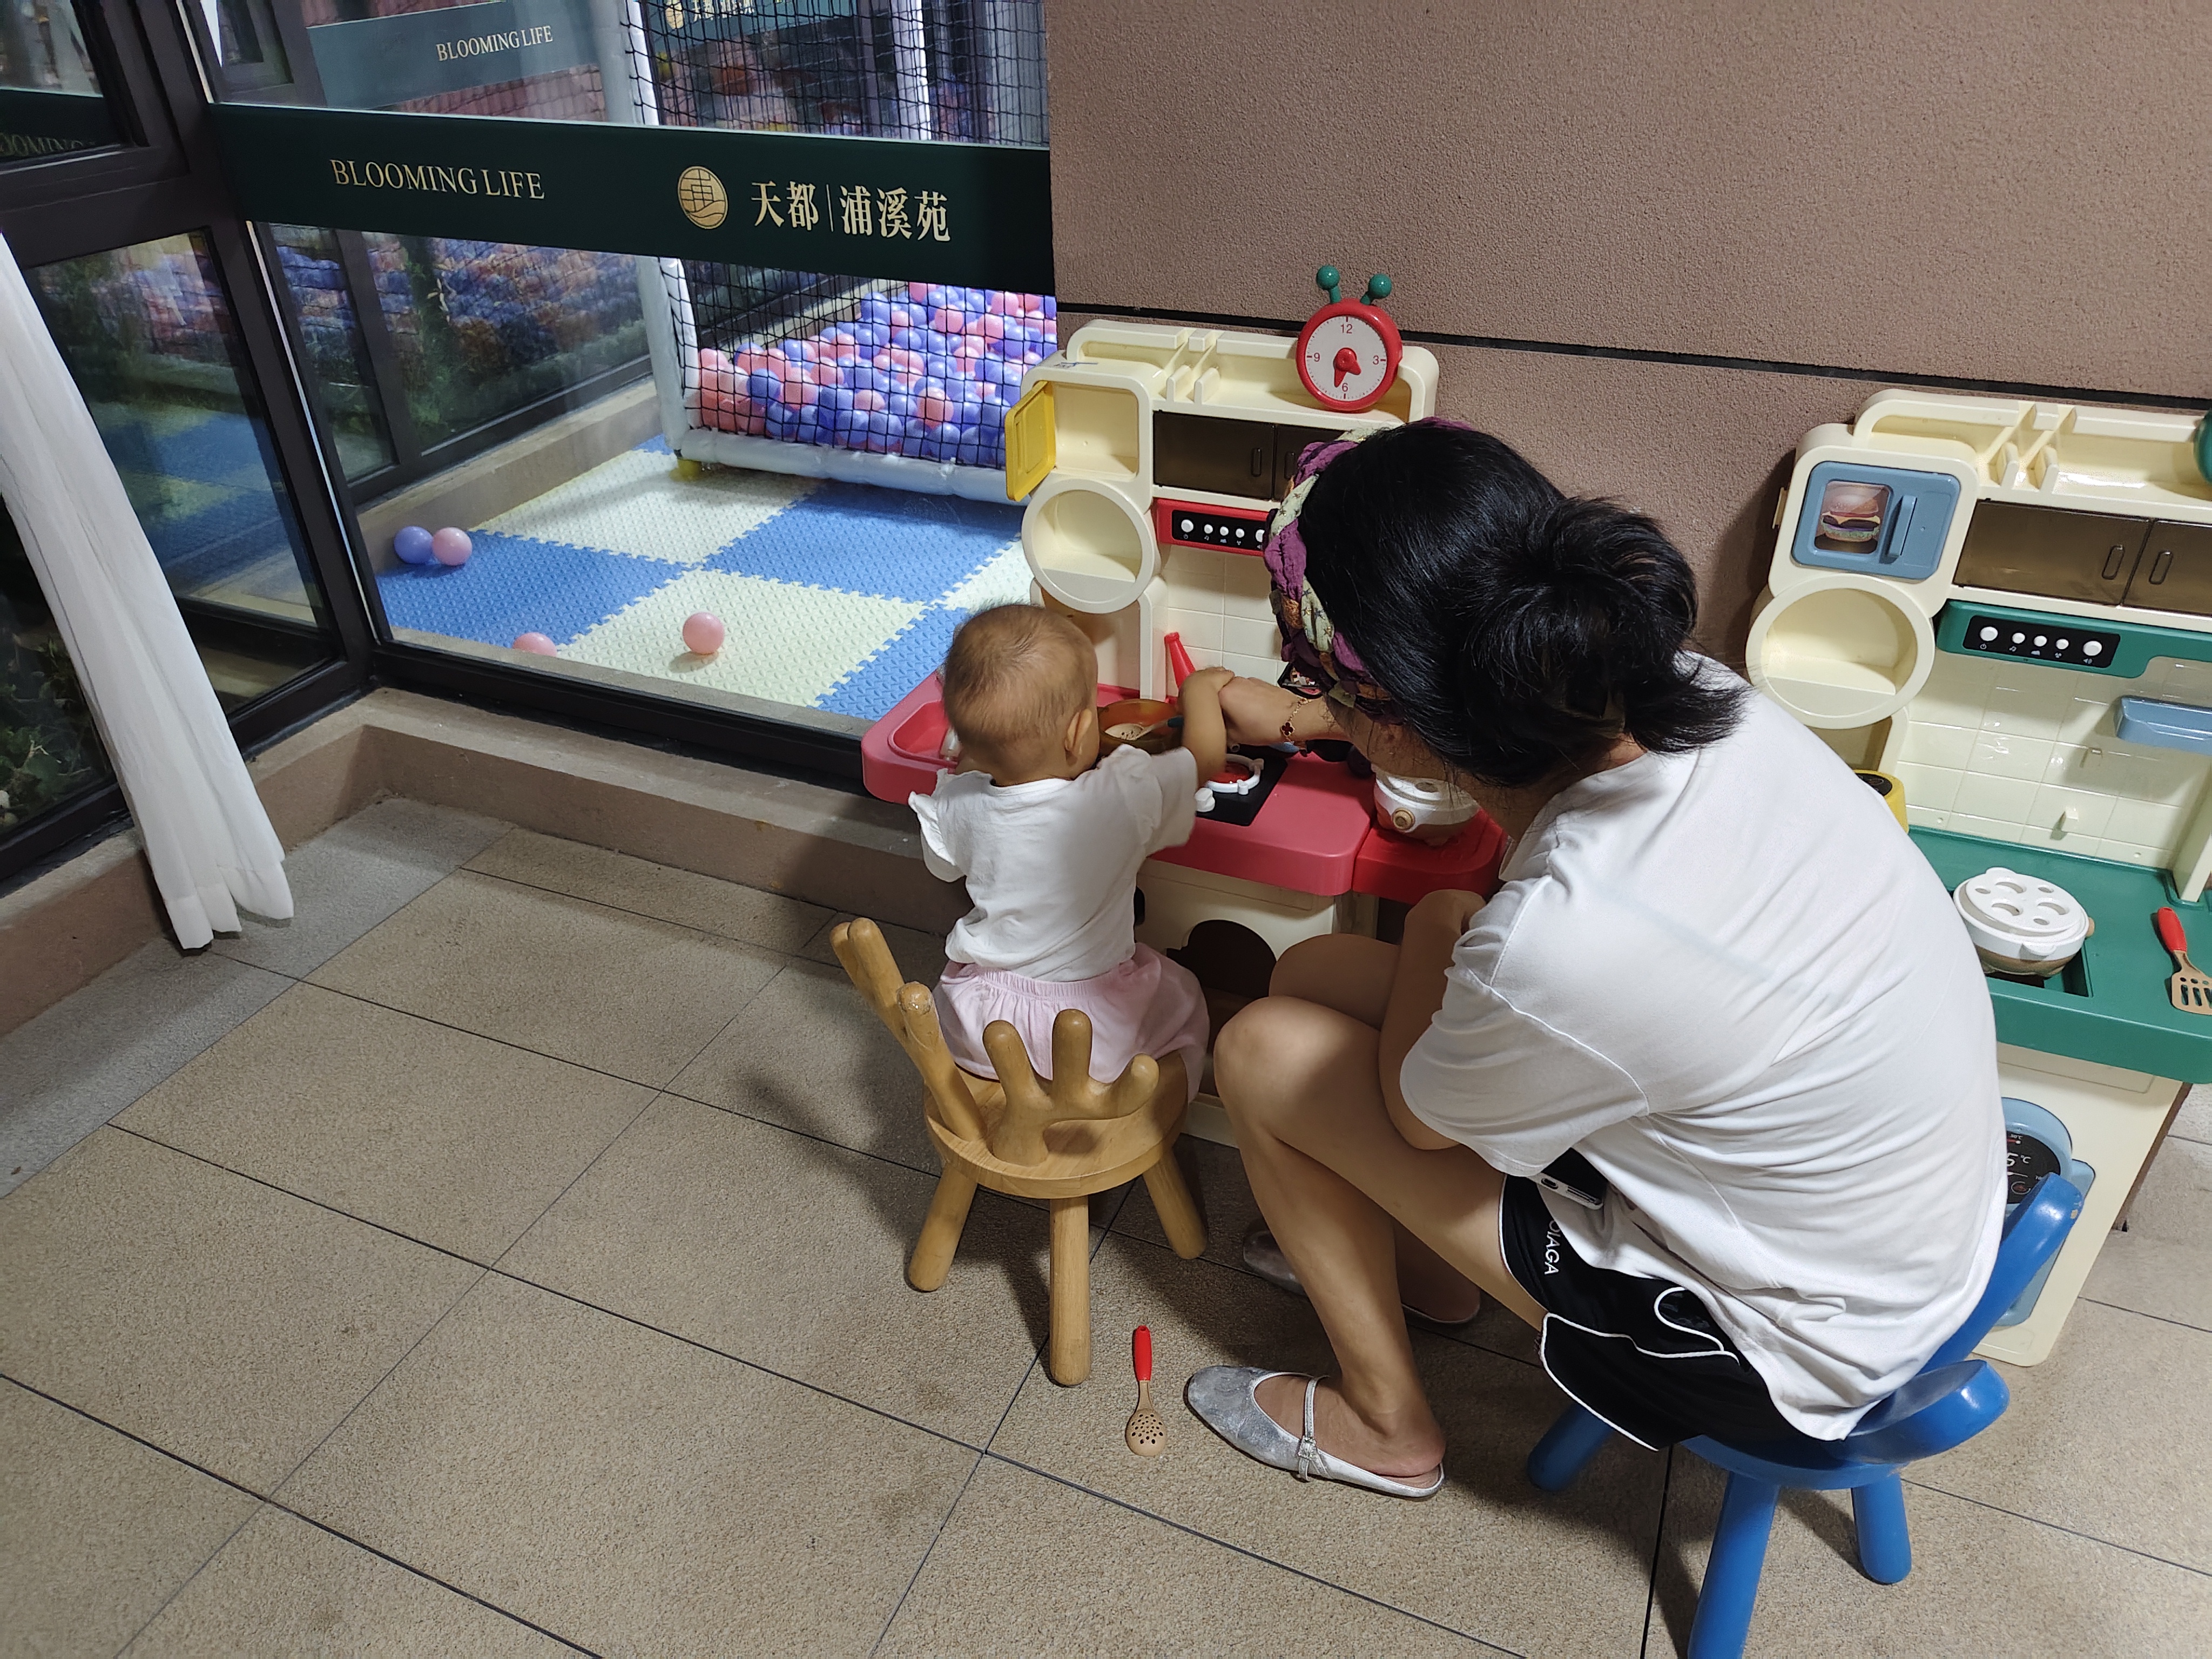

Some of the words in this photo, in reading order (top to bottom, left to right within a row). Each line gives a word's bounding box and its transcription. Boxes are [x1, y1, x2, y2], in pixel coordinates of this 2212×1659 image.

[436, 31, 520, 62] BLOOMING
[521, 25, 554, 46] LIFE
[329, 159, 478, 194] BLOOMING
[481, 168, 545, 200] LIFE
[1340, 323, 1353, 334] 12
[1313, 352, 1320, 362] 9
[1372, 355, 1379, 365] 3
[1341, 382, 1348, 392] 6
